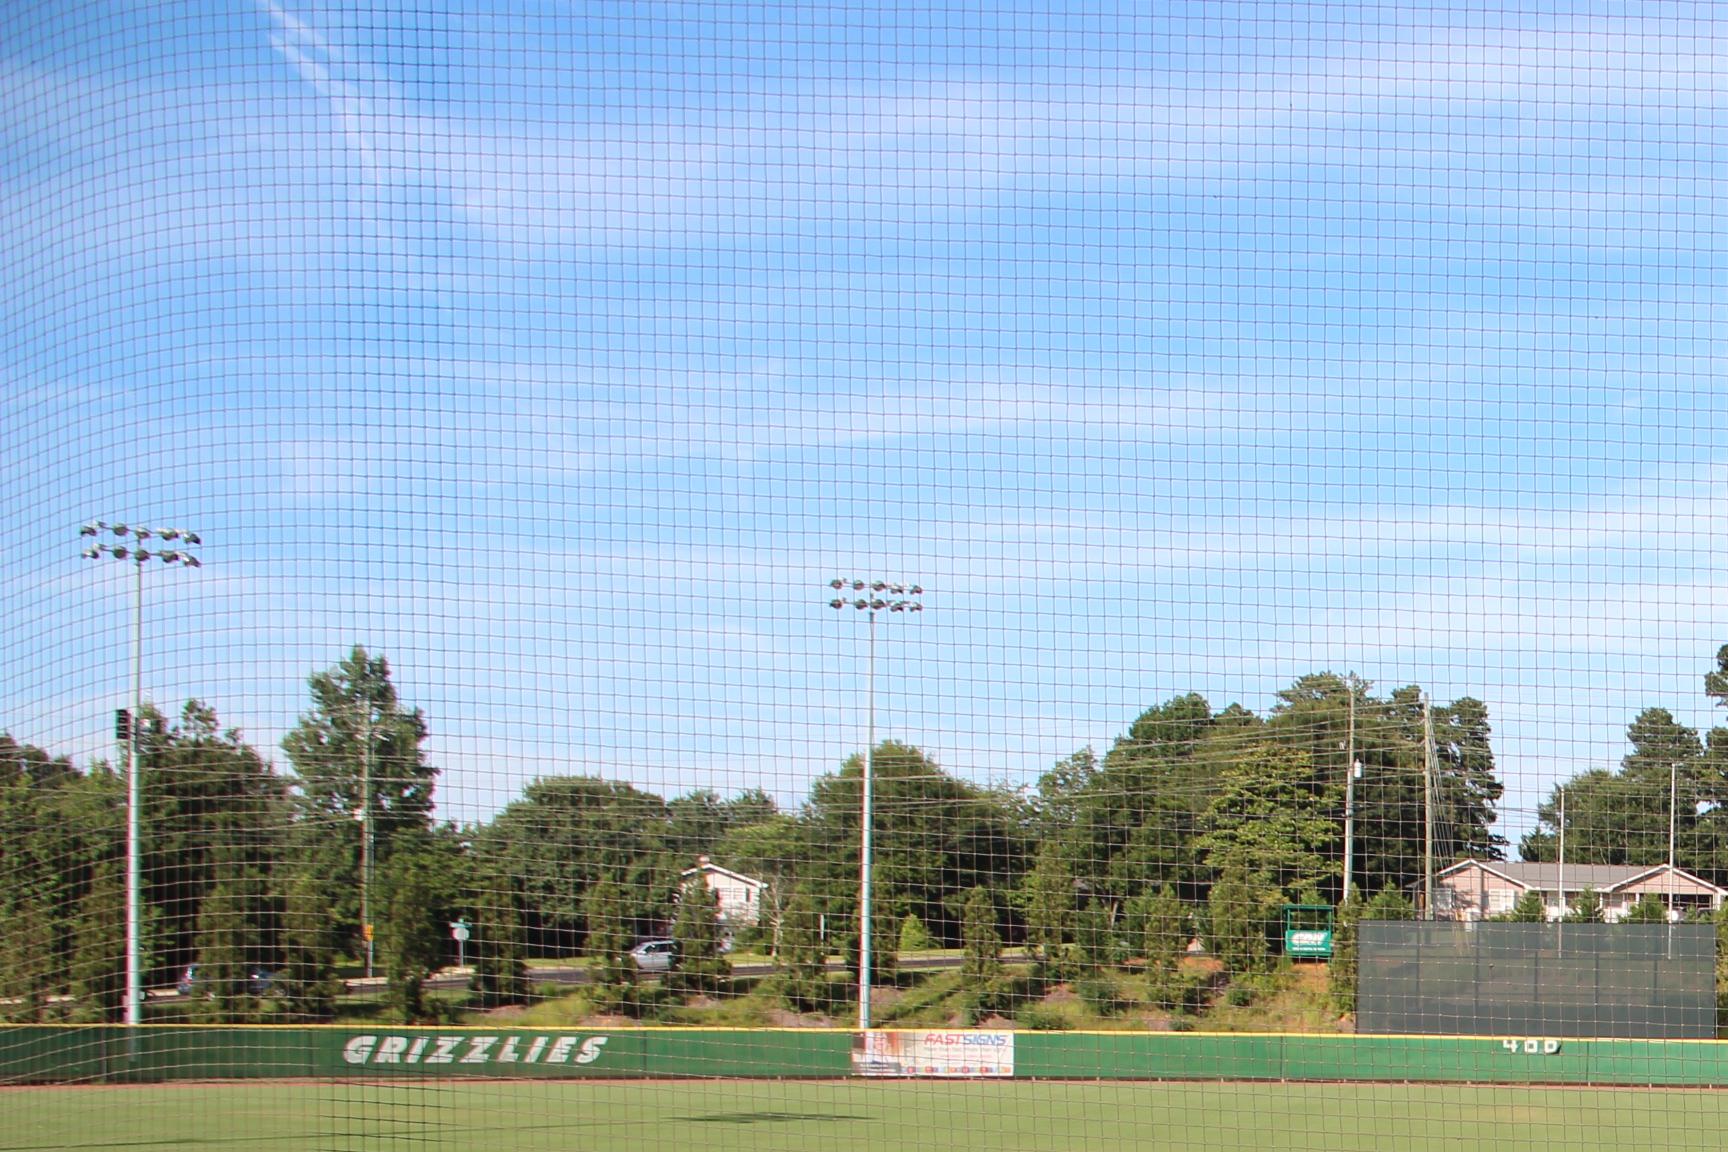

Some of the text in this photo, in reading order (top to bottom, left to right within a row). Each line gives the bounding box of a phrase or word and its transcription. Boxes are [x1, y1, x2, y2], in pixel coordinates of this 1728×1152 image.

[925, 1033, 1008, 1046] FASTSIGNS
[342, 1035, 609, 1064] GRIZZLIES
[1503, 1040, 1558, 1054] 400
